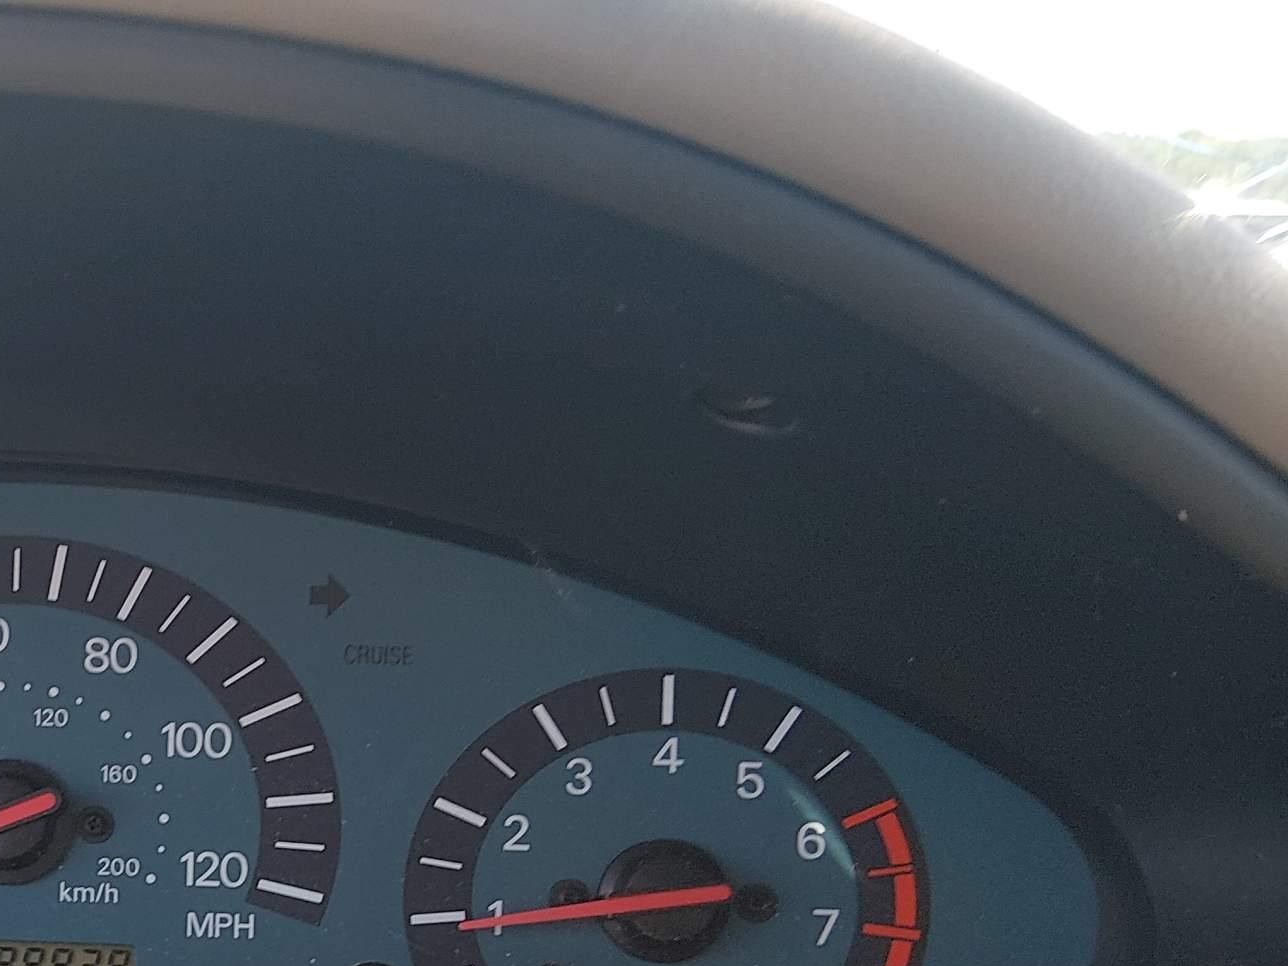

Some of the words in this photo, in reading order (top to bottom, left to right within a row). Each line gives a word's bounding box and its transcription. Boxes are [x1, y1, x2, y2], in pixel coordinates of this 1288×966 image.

[85, 638, 137, 673] 80
[344, 644, 413, 665] CRUISE
[34, 709, 68, 727] 120
[162, 723, 231, 758] 100
[653, 738, 684, 773] 4
[101, 765, 136, 783] 160
[566, 758, 592, 794] 3
[738, 762, 764, 798] 5
[503, 815, 529, 850] 2
[799, 822, 825, 858] 6
[98, 858, 139, 876] 200
[181, 852, 247, 887] 120
[60, 882, 118, 903] km/h
[187, 912, 254, 938] MPH
[488, 901, 502, 935] 1
[813, 909, 839, 945] 7
